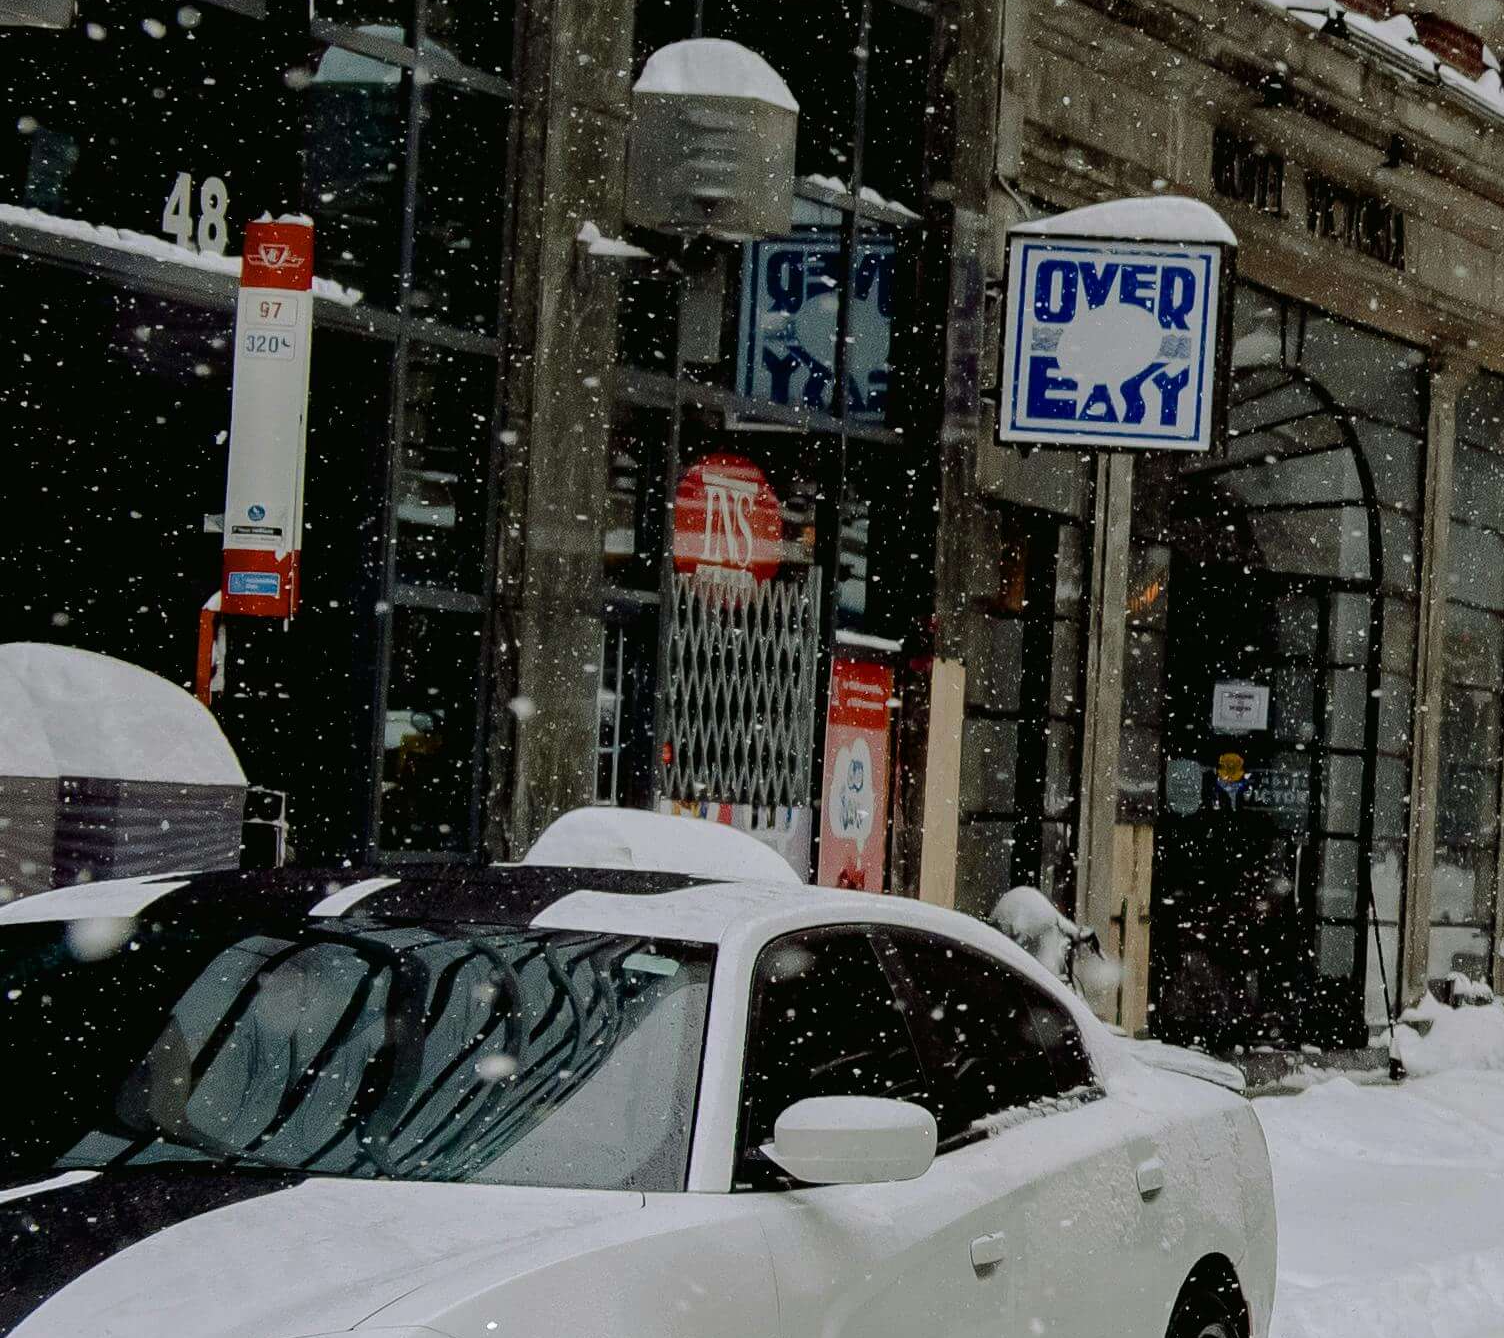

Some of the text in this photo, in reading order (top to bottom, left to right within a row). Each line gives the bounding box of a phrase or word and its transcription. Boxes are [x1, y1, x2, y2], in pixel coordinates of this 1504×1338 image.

[163, 172, 228, 256] 48
[260, 301, 282, 319] 97
[1034, 259, 1196, 330] OVER
[1027, 356, 1190, 426] EASY
